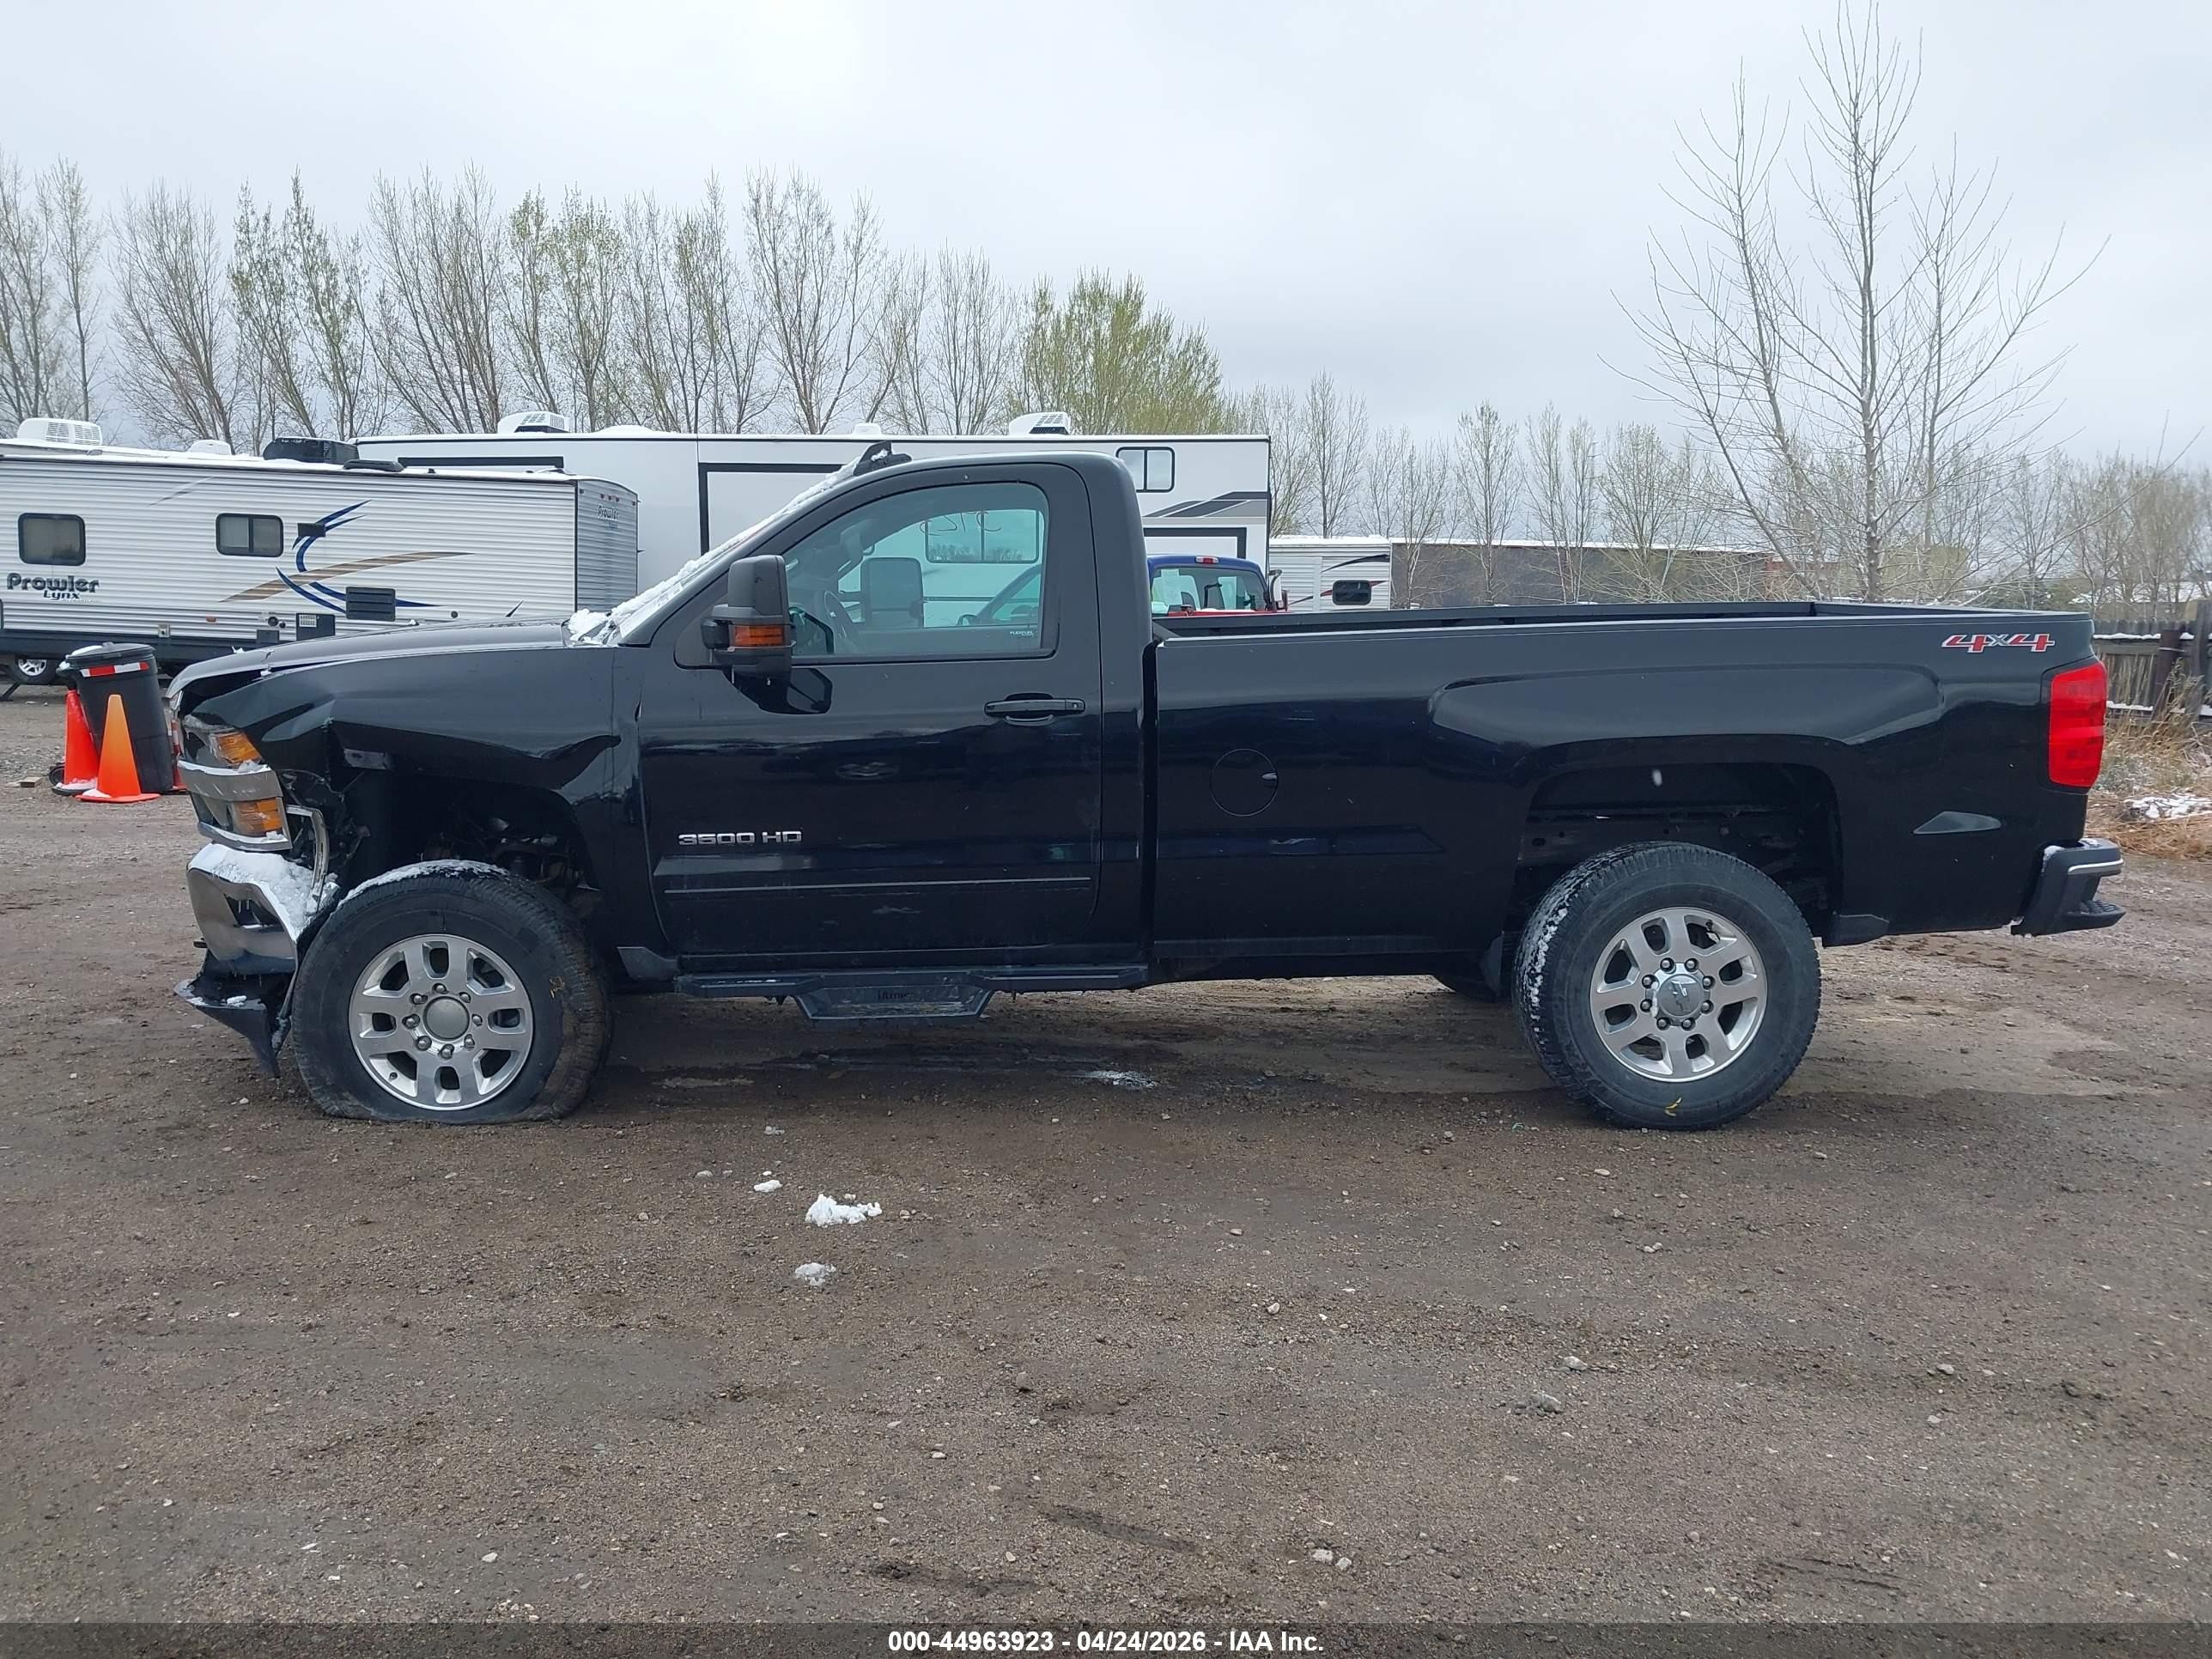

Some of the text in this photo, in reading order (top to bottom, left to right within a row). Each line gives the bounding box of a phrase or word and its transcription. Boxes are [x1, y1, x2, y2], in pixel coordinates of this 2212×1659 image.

[7, 573, 100, 592] Prowler
[43, 590, 80, 600] Lynx
[678, 831, 802, 845] 3500 HD
